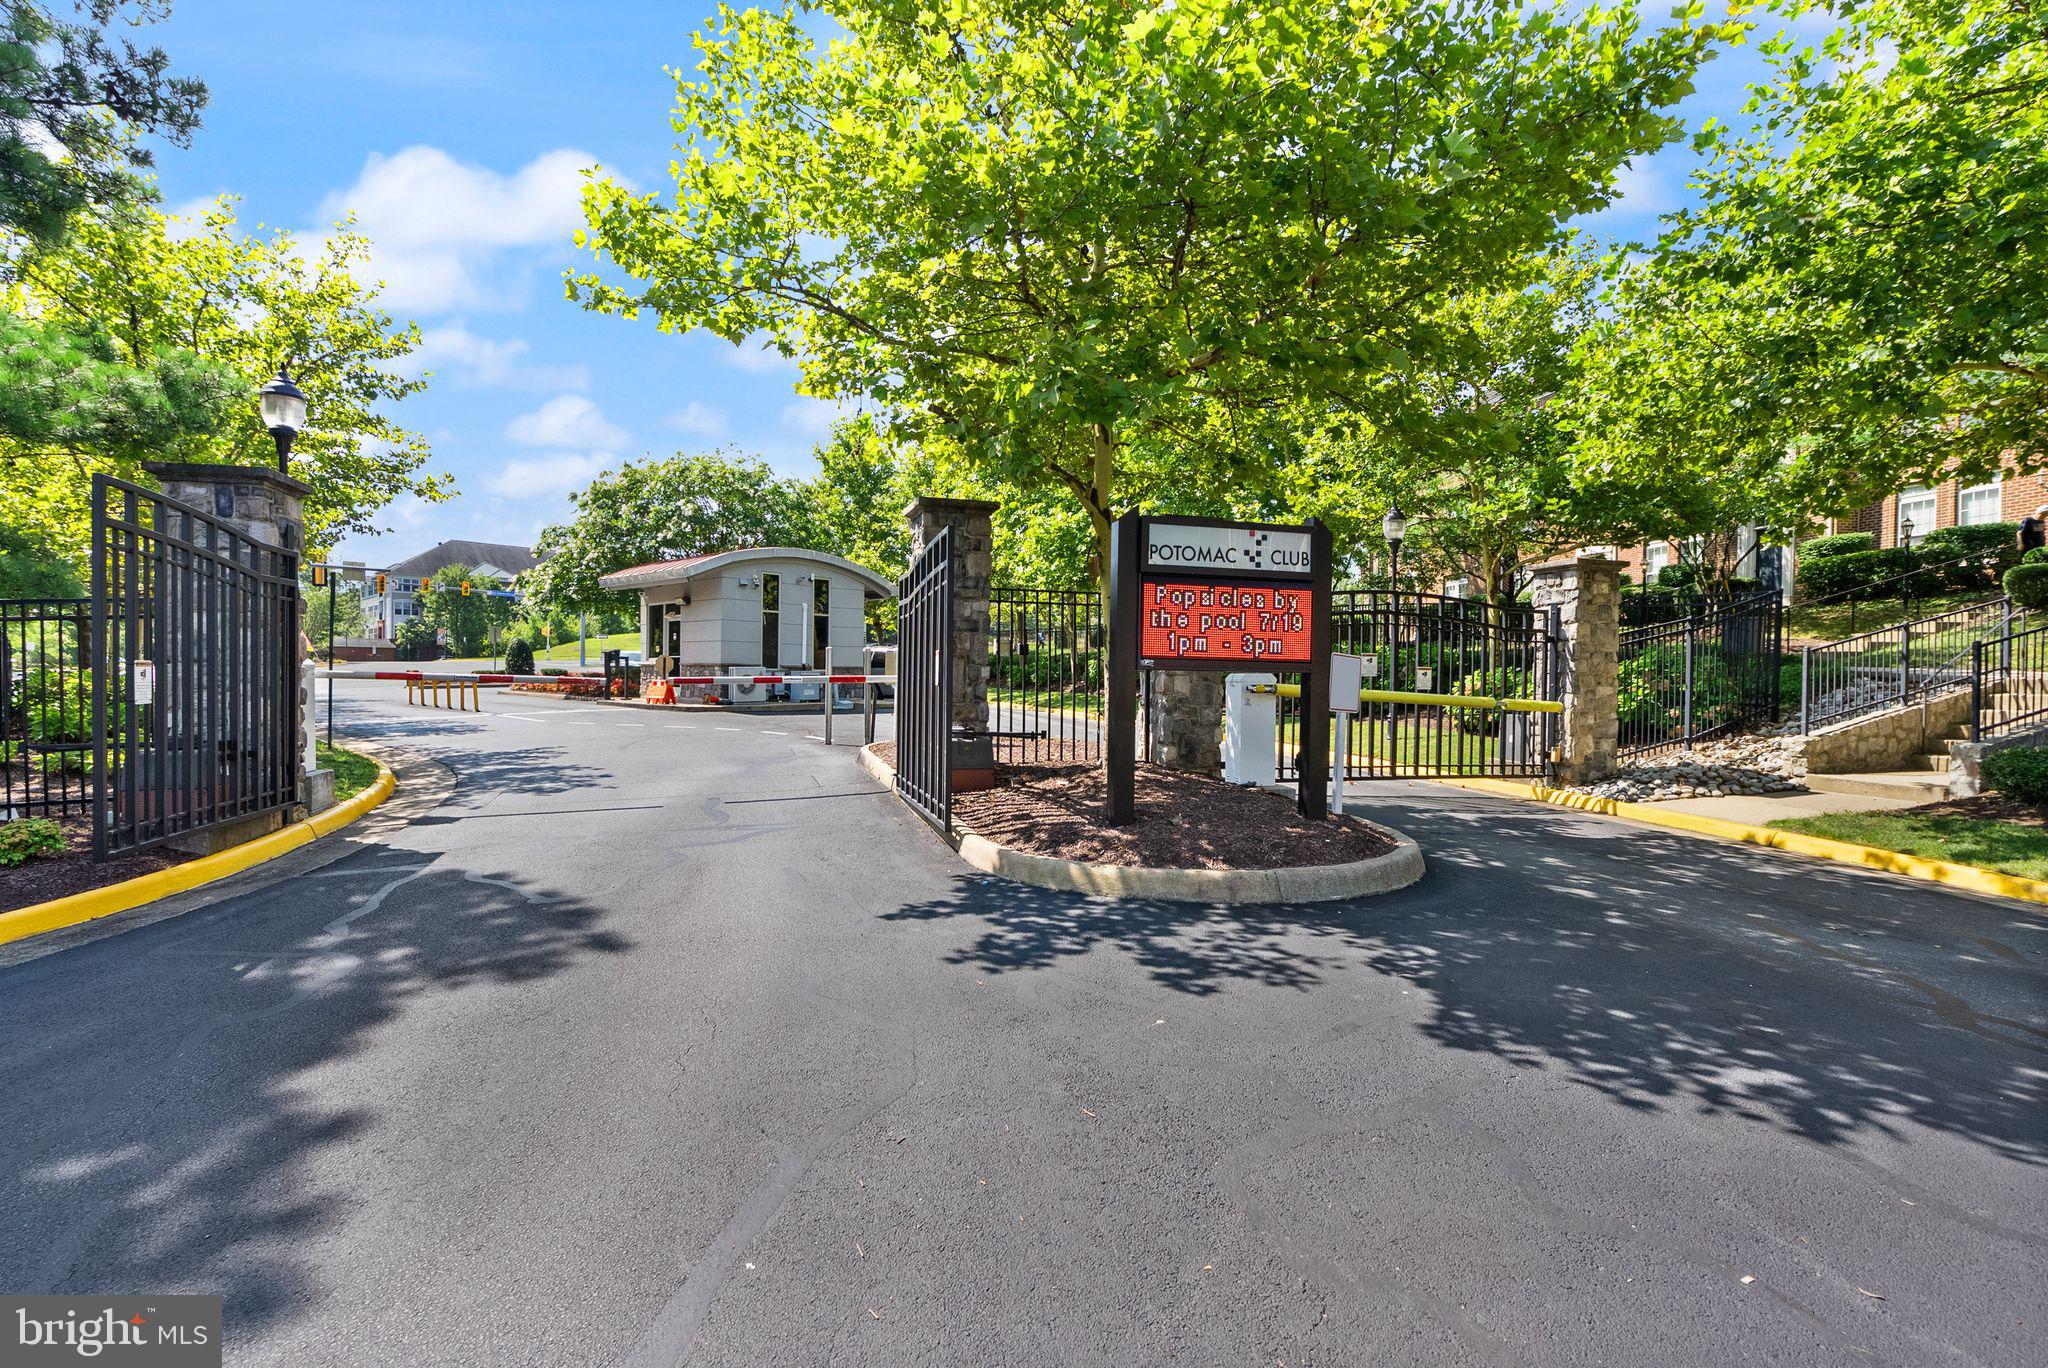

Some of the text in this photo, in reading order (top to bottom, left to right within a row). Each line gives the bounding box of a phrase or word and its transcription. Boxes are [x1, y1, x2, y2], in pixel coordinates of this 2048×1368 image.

[1149, 544, 1310, 567] POTOMAC CLUB
[1156, 586, 1299, 613] Popsicles by
[1151, 609, 1188, 627] the
[1201, 612, 1245, 632] pool
[1169, 632, 1207, 655] 1pm
[1242, 635, 1282, 657] 3pm
